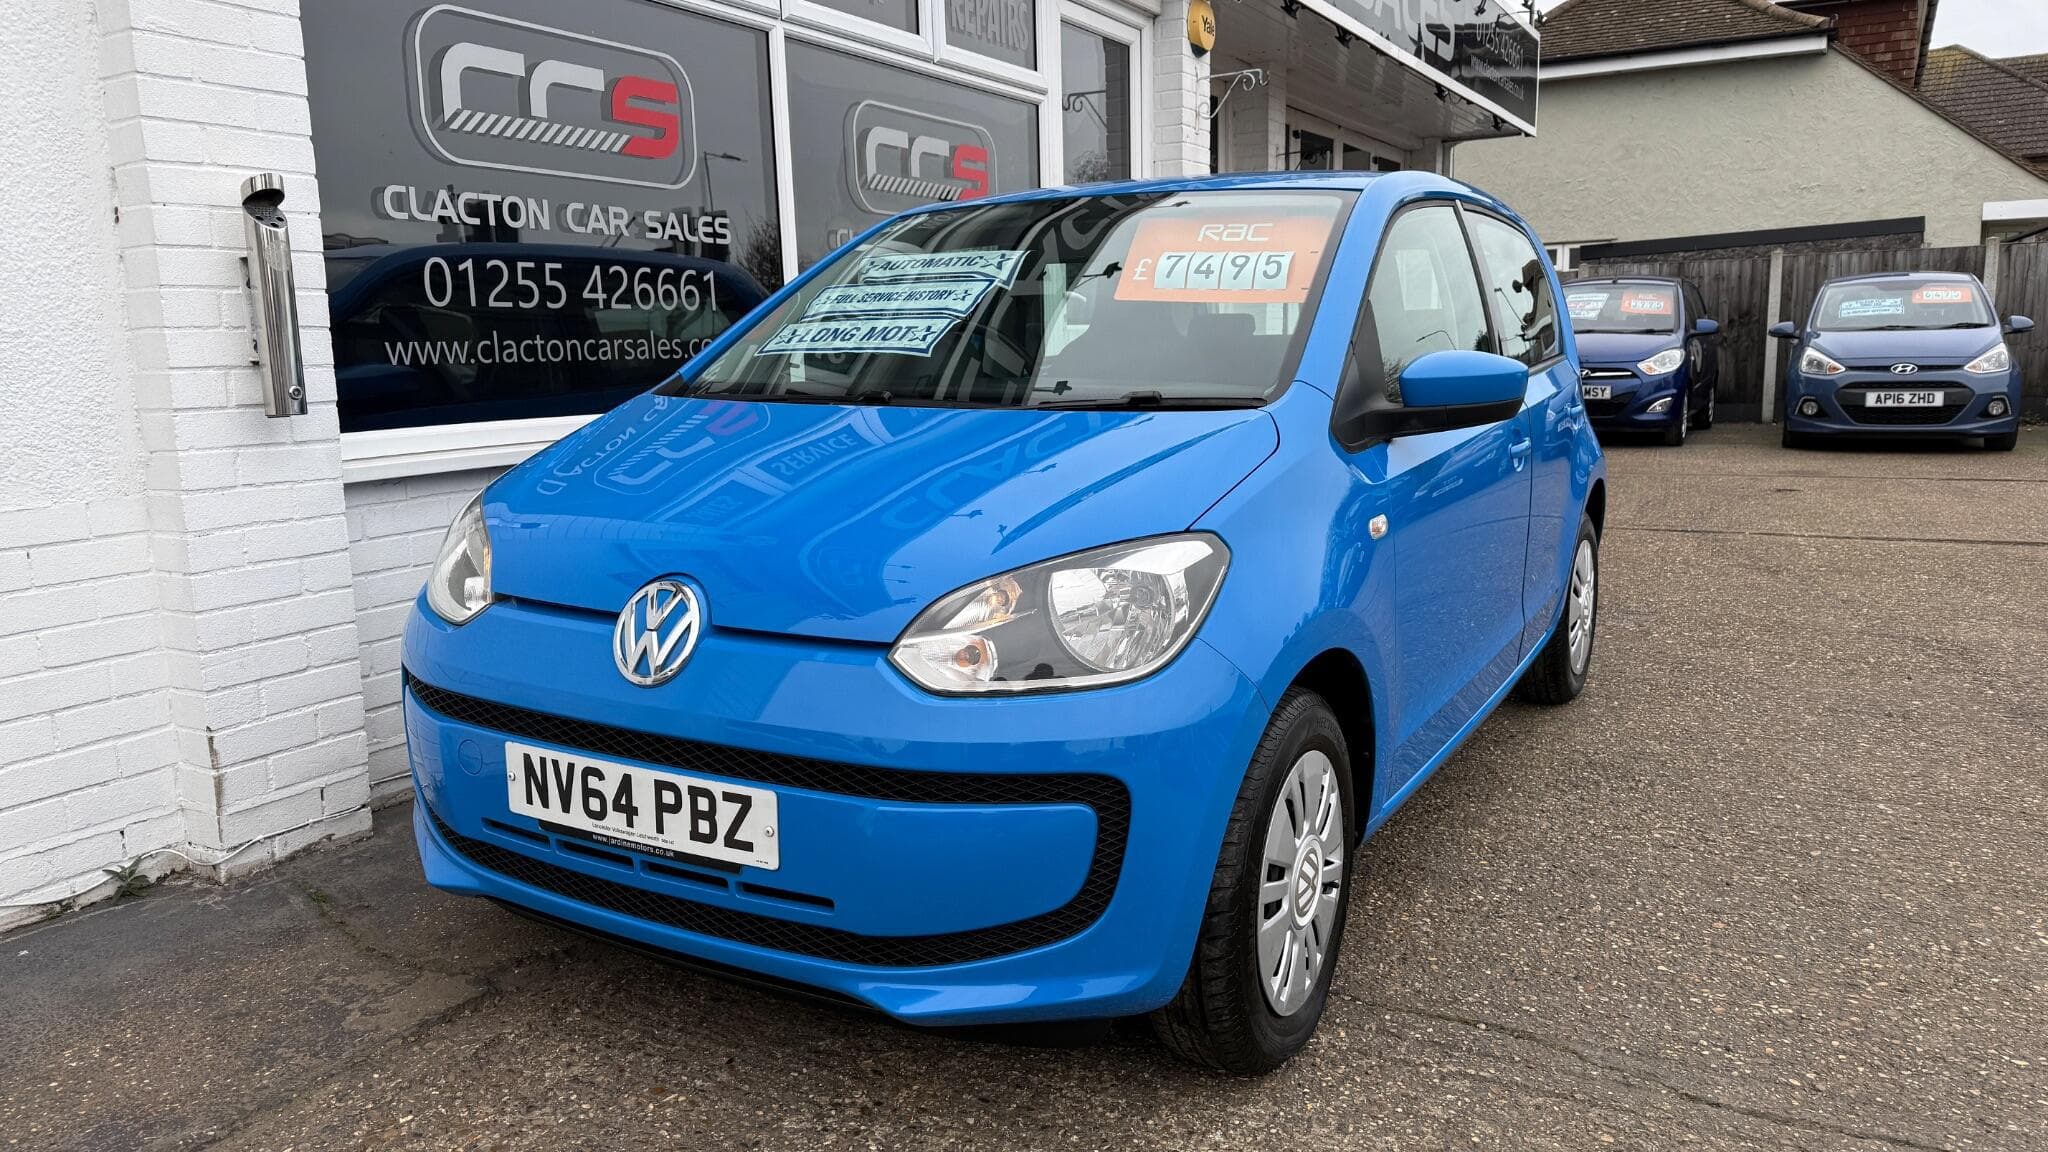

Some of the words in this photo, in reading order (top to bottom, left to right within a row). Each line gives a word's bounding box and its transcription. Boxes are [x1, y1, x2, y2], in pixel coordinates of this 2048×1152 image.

[951, 0, 1029, 50] REPAIRS
[1201, 15, 1215, 37] Yale
[1476, 18, 1499, 54] 01255
[1501, 33, 1524, 73] 426661
[441, 42, 680, 160] CCS
[866, 126, 989, 200] CCS
[384, 185, 550, 231] CLACTON
[566, 202, 630, 237] CAR
[643, 211, 732, 245] SALES
[423, 257, 567, 309] 01255
[582, 265, 717, 312] 426661
[875, 256, 981, 271] AUTOMATIC
[834, 293, 859, 304] FULL
[857, 291, 907, 303] SERVICE
[903, 289, 958, 301] HISTORY
[797, 327, 862, 343] LONG
[860, 326, 917, 342] MOT
[1874, 393, 1905, 405] AP16
[1908, 393, 1936, 404] ZHD
[522, 752, 639, 829] NV64
[653, 778, 754, 853] PBZ
